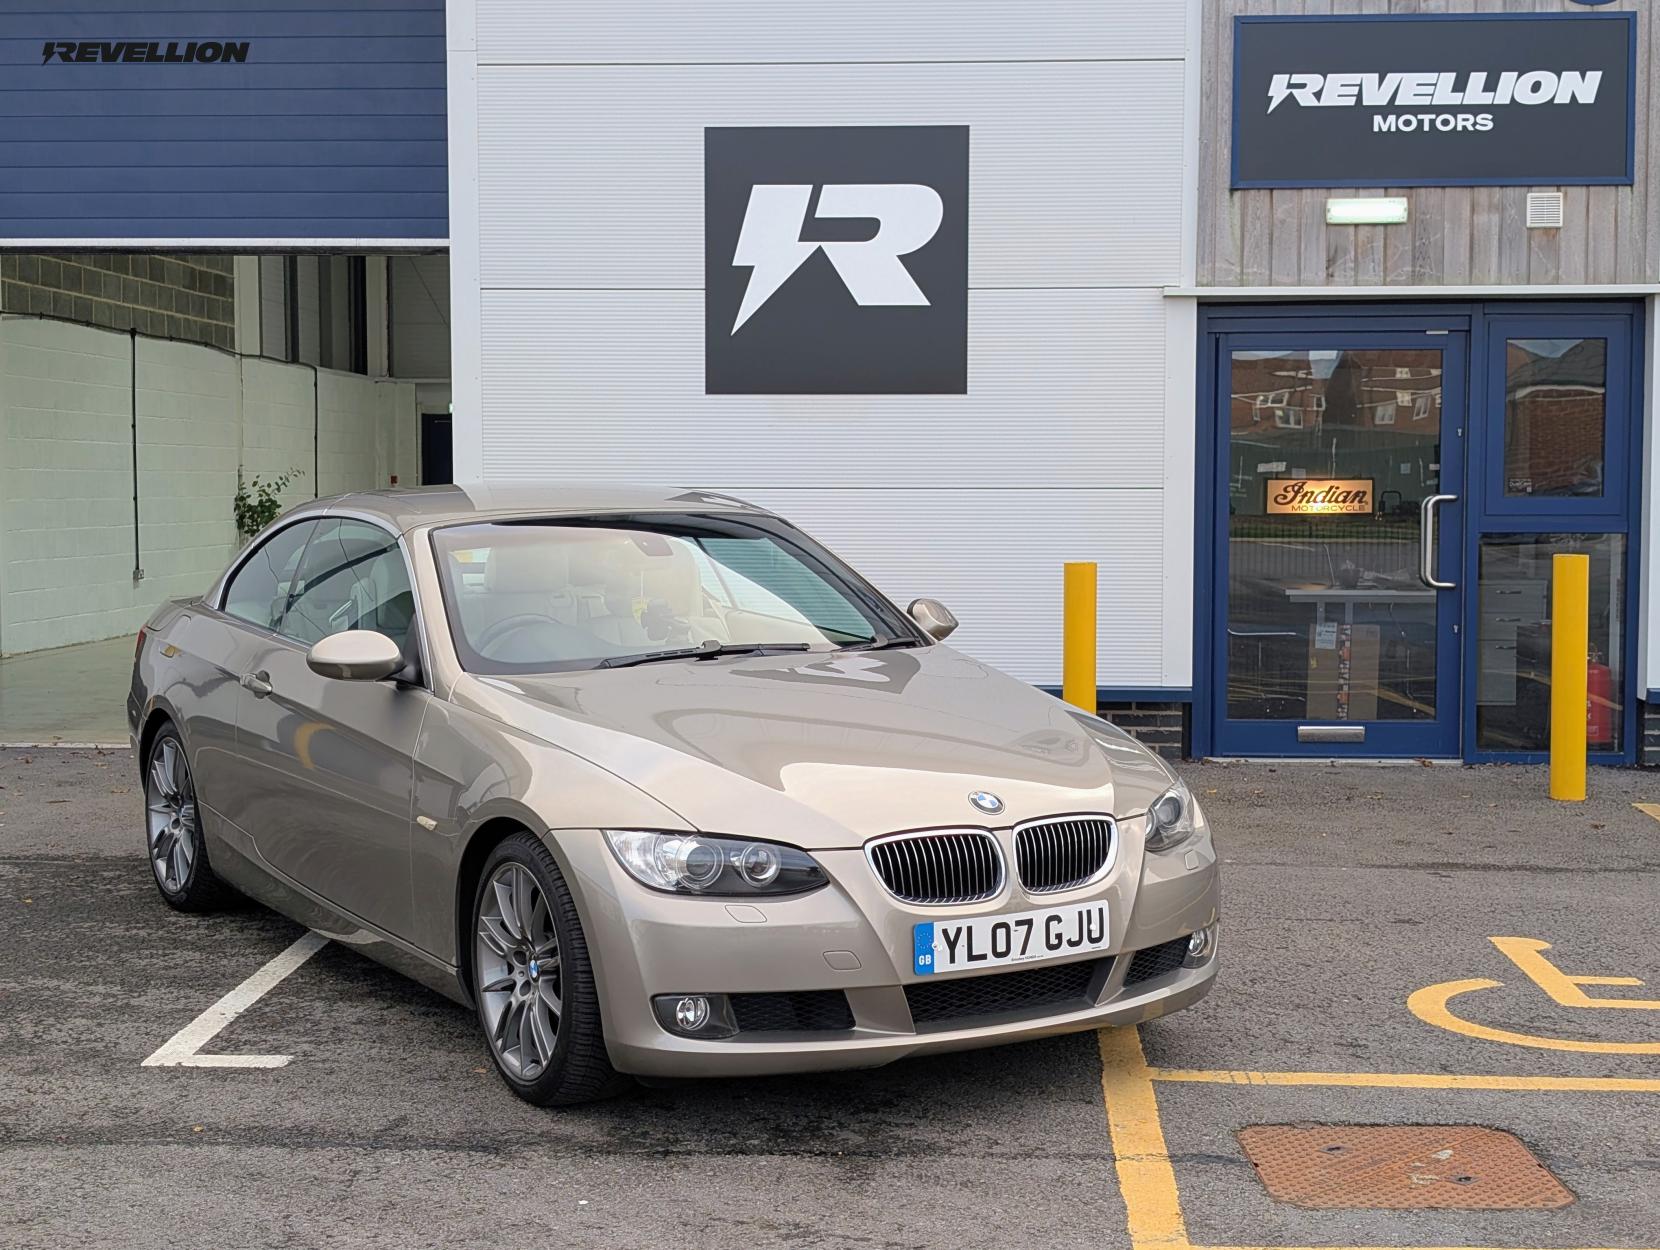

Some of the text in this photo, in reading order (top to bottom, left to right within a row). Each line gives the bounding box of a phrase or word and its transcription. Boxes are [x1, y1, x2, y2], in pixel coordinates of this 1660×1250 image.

[42, 42, 250, 65] REVELLION
[1267, 71, 1602, 114] REVELLION
[1373, 113, 1494, 133] MOTORS
[1274, 481, 1367, 505] Indian
[941, 907, 1105, 965] YL07 GJU
[918, 954, 932, 966] GB
